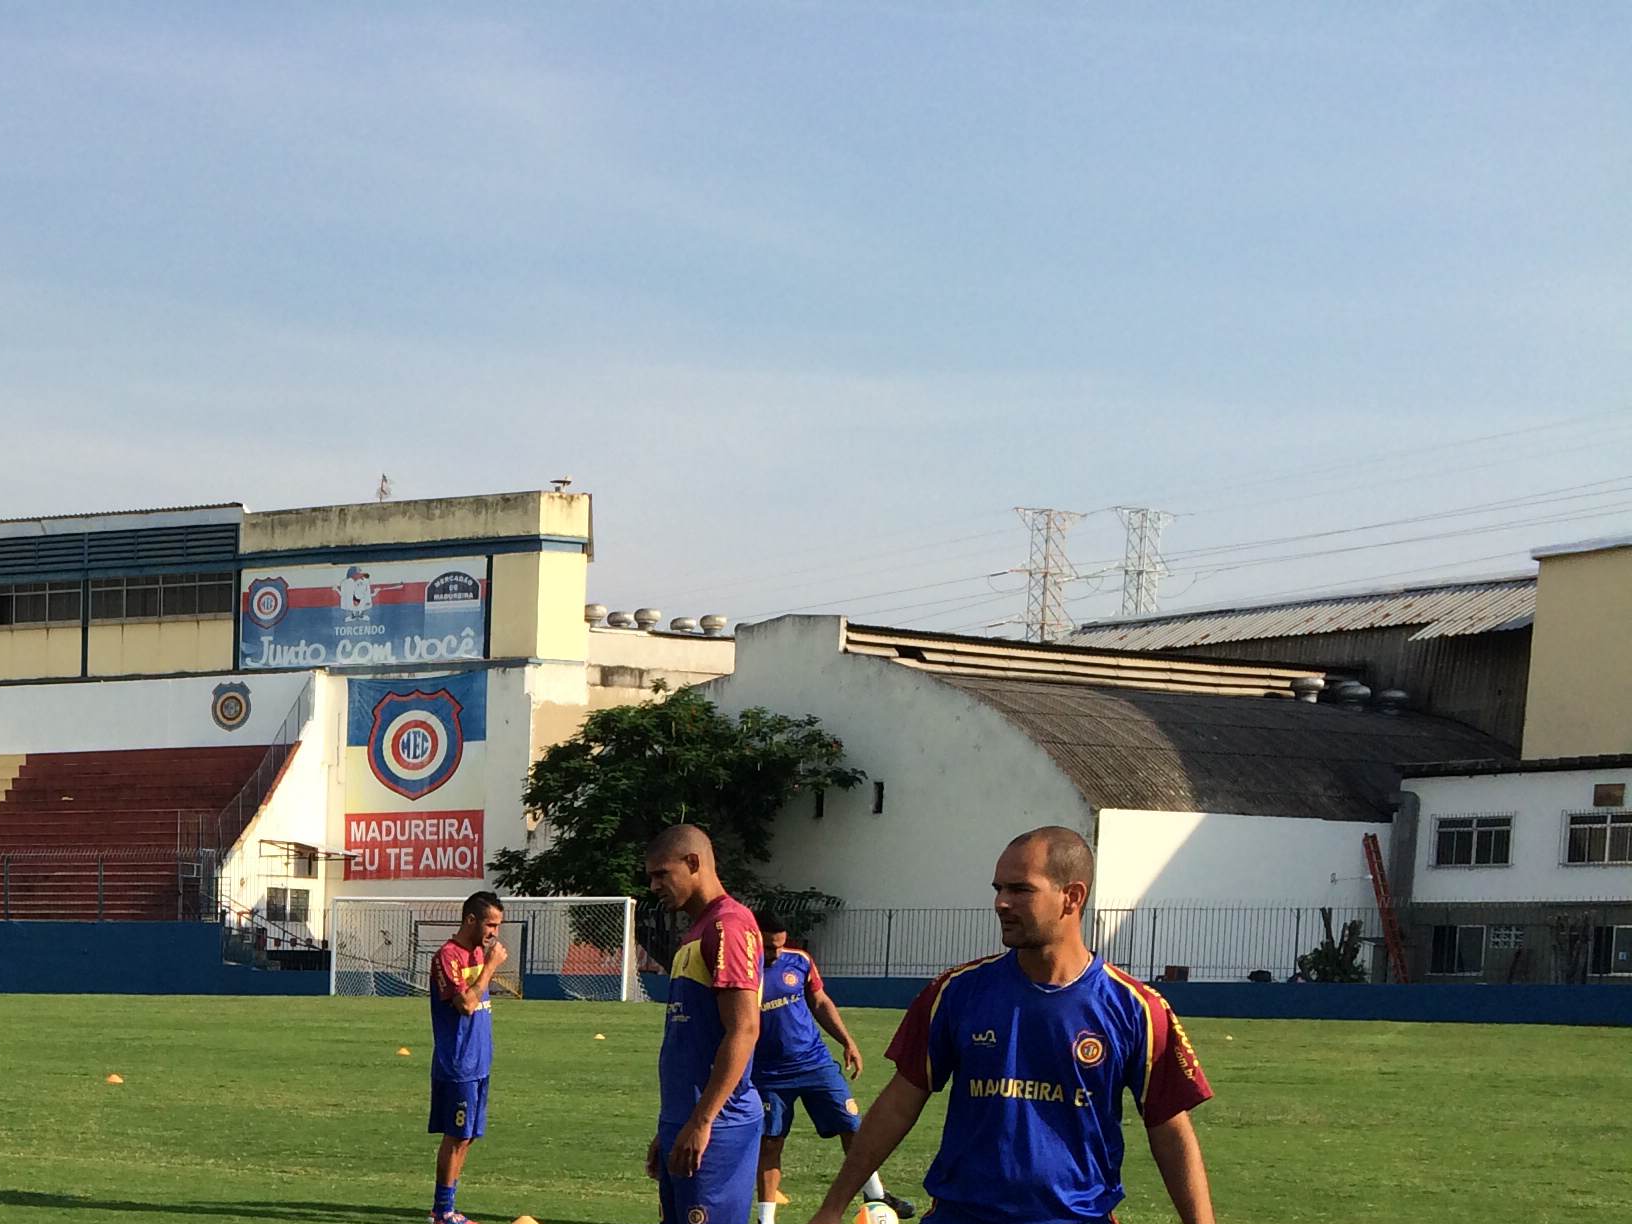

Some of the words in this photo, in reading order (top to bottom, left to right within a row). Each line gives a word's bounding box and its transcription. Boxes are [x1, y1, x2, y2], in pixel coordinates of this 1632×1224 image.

[334, 624, 386, 636] TORCENDO
[349, 818, 480, 843] MADUREIRA,
[350, 848, 380, 872] EU
[386, 847, 415, 871] TE
[419, 845, 479, 871] AMO!
